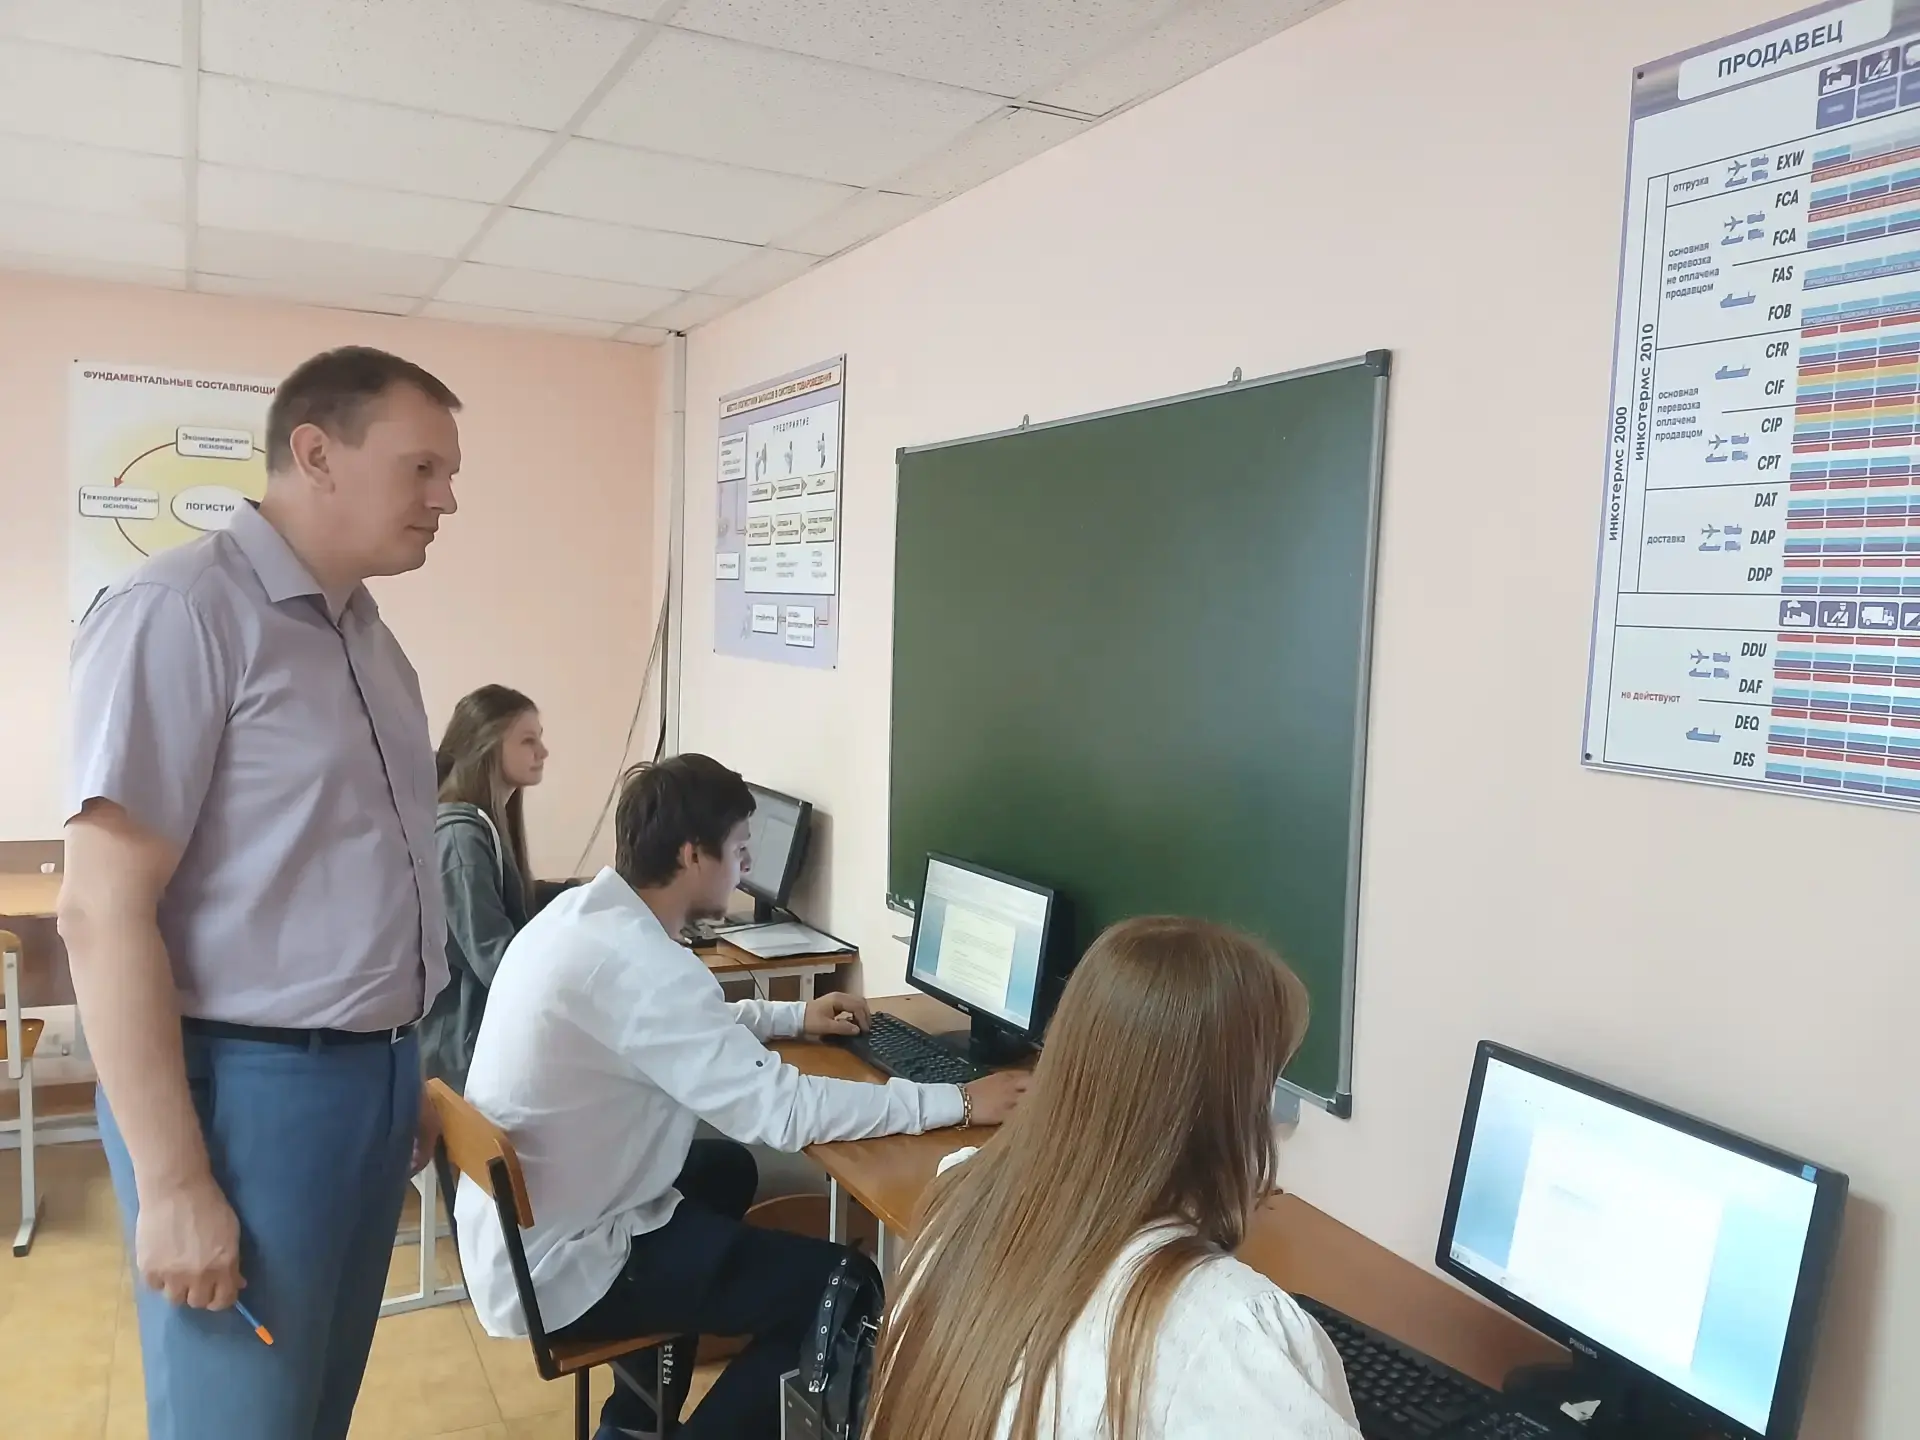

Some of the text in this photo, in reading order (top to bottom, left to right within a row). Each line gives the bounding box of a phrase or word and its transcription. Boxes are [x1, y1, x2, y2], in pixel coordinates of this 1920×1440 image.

[1718, 19, 1844, 79] ПРОДАВЕЦ
[1777, 150, 1805, 171] EXW
[1672, 176, 1709, 193] отгрузка
[1774, 189, 1799, 209] FCA
[1772, 227, 1796, 246] FCA
[1668, 242, 1710, 258] основная
[1667, 255, 1712, 272] перевозка
[1666, 267, 1720, 286] не оплачена
[1771, 265, 1794, 284] FAS
[1665, 283, 1714, 301] продавцом
[1767, 303, 1792, 322] FOB
[1765, 342, 1790, 359] CFR
[83, 370, 277, 396] ФУНДАМЕНТАЛЬНЫЕ СОСТАВЛЯЮЩИ
[1764, 378, 1786, 396] CIF
[1635, 323, 1654, 461] инкотермс 2010
[1658, 387, 1699, 399] основная
[1657, 401, 1701, 414] перевозка
[1656, 415, 1697, 427] оплачена
[1761, 416, 1783, 433] CIP
[182, 433, 250, 445] Экономические
[1655, 429, 1703, 442] продавцом
[198, 443, 233, 451] основы
[1757, 454, 1782, 471] CPT
[1609, 406, 1628, 541] инкотермс 2000
[82, 492, 159, 503] Технологические
[1754, 491, 1779, 508] DAT
[102, 503, 138, 511] основы
[1646, 535, 1686, 546] доставка
[1750, 529, 1776, 545] DAP
[1747, 566, 1773, 582] DDP
[1741, 641, 1768, 658] DDU
[1738, 678, 1763, 694] DAF
[1620, 690, 1681, 705] не действуют
[1734, 715, 1760, 731] DEQ
[1732, 751, 1756, 768] DES
